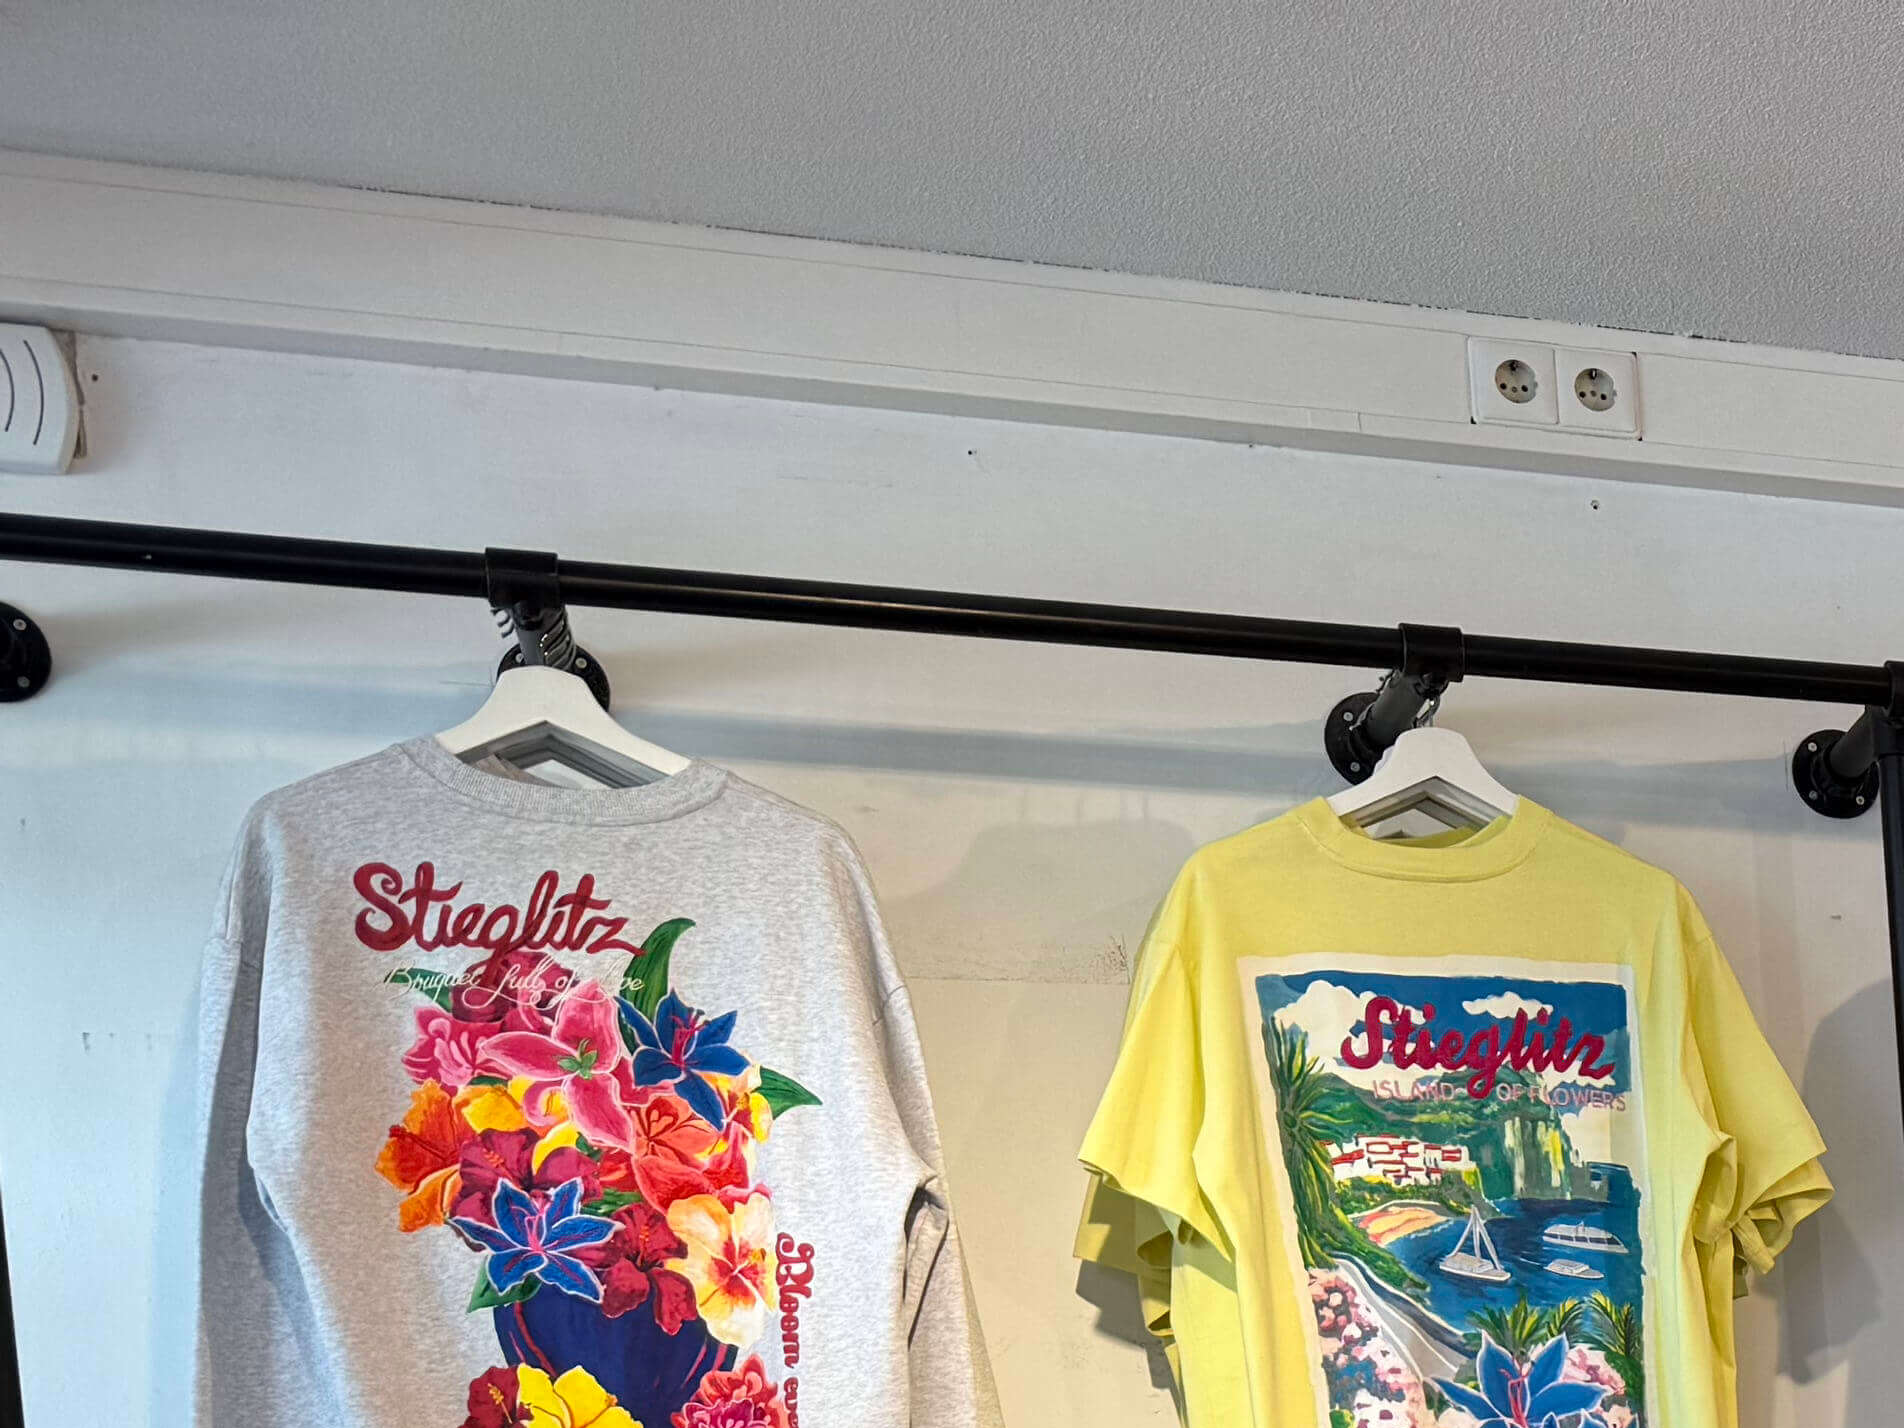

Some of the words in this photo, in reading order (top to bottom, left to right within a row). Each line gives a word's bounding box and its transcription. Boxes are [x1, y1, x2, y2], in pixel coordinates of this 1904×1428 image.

[353, 860, 647, 975] Stieglitz
[1340, 995, 1617, 1100] Stieglitz
[1372, 1079, 1456, 1102] ISLAND
[1530, 1085, 1627, 1112] FLOWERS
[775, 1231, 816, 1369] Bloom
